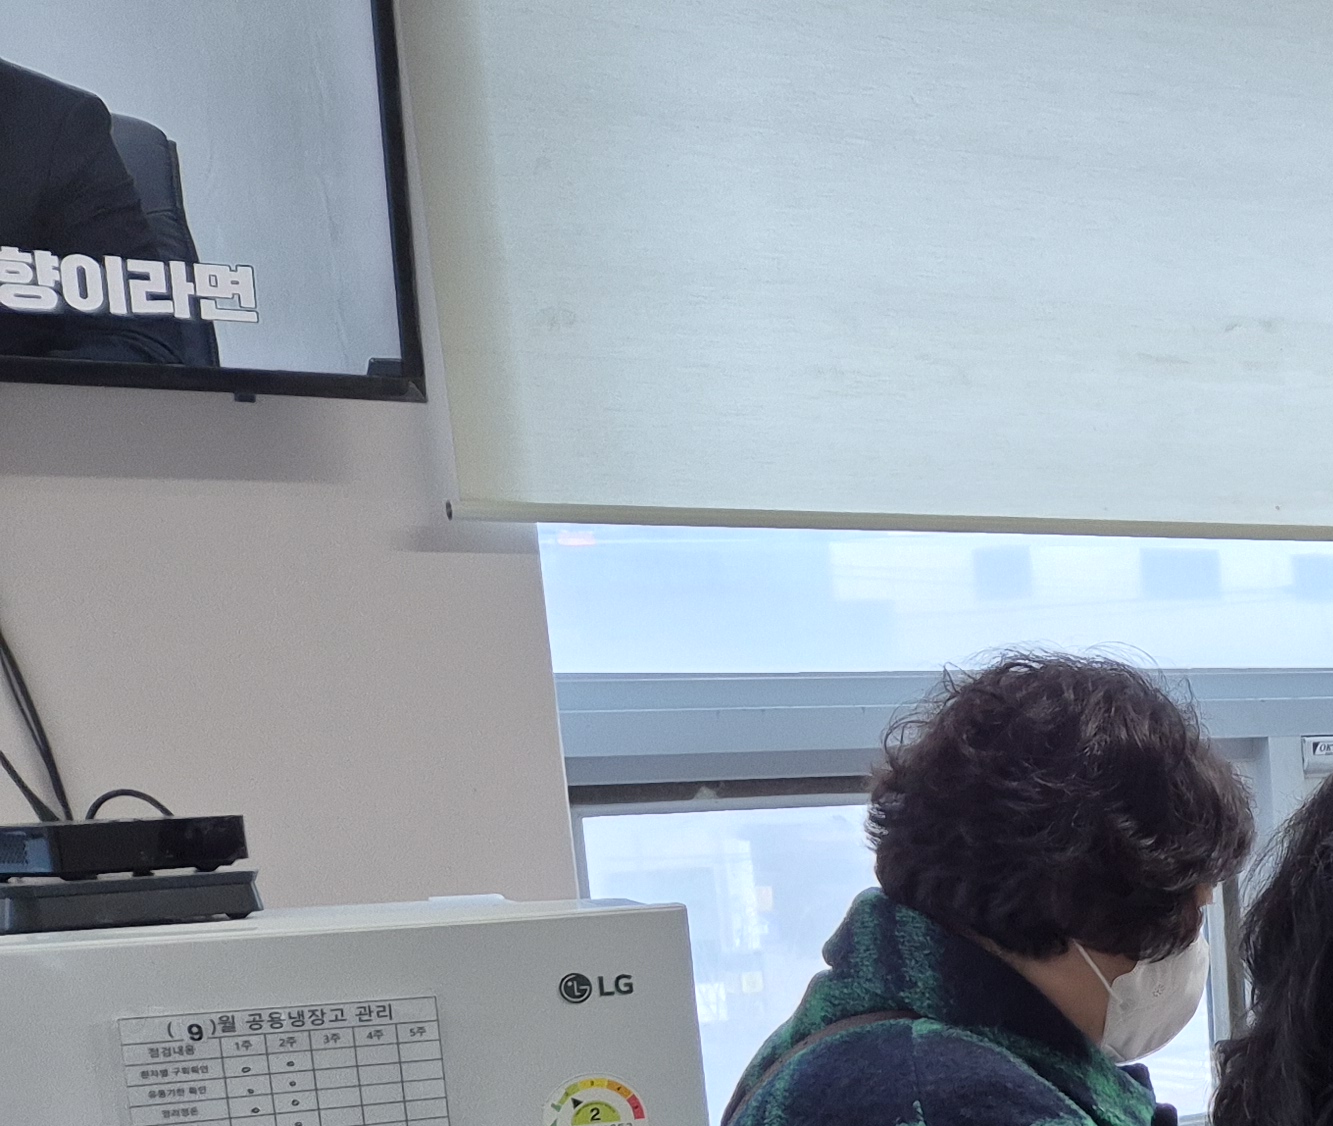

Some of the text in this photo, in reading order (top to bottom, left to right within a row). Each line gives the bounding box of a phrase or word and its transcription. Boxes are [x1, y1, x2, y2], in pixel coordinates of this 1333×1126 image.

[0, 244, 259, 323] 향이라면
[598, 974, 633, 996] LG
[245, 1008, 347, 1031] 공용냉장고
[355, 1003, 393, 1022] 관리
[148, 1026, 427, 1058] 점검내용 1주 2주 3주 4주 5주
[590, 1107, 601, 1122] 2
